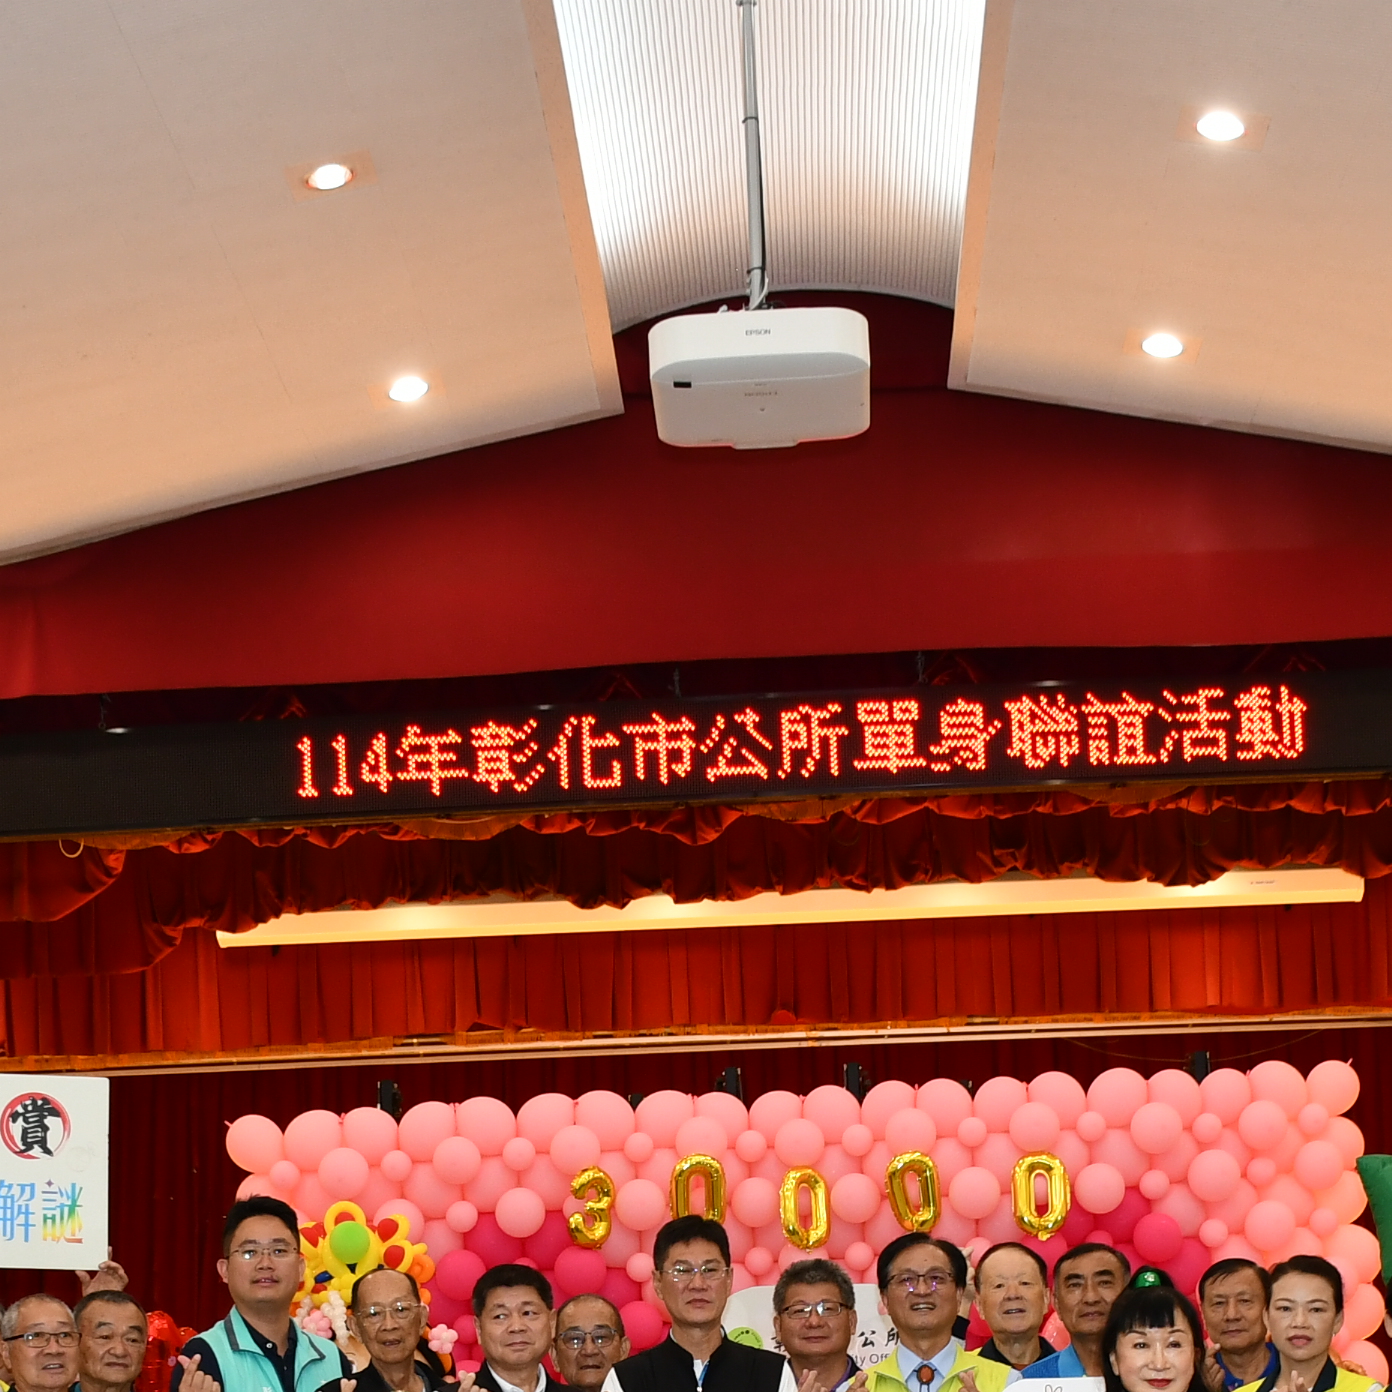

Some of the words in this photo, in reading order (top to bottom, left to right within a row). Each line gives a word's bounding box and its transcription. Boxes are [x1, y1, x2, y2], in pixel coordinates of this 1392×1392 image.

[296, 683, 1307, 797] 114年彰化市公所單身聯誼活動
